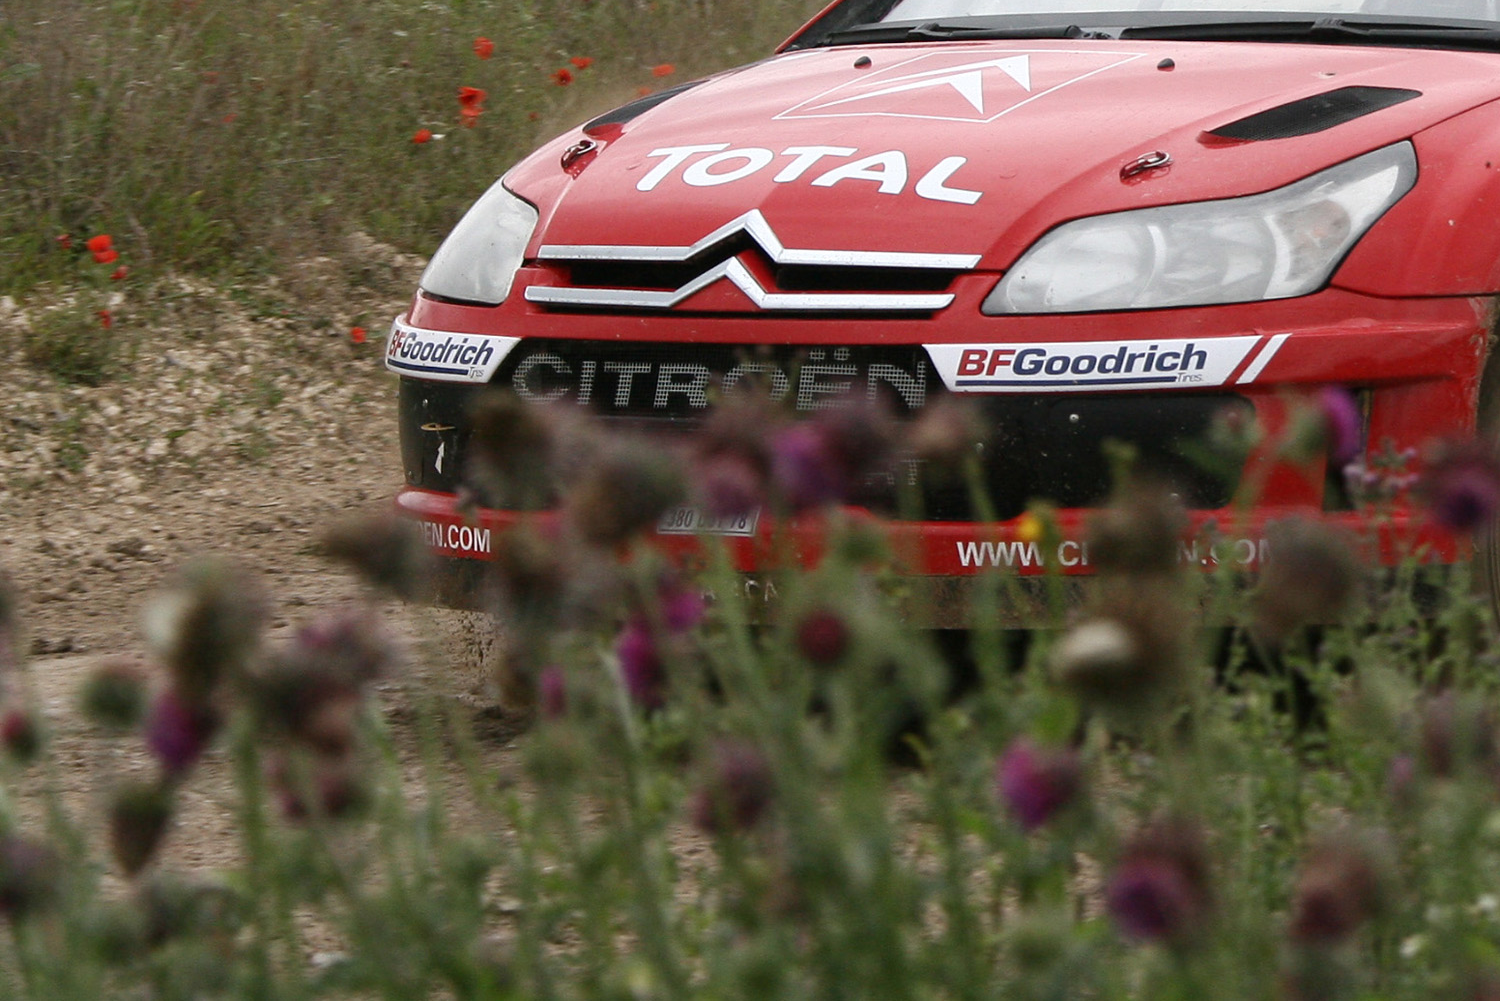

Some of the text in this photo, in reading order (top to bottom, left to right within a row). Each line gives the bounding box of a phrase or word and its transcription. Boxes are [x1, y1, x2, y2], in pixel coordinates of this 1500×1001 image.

[636, 142, 985, 206] TOTAL
[388, 329, 494, 366] BFGoodrich
[956, 343, 1208, 377] BFGoodrich
[511, 347, 927, 411] CITROËN
